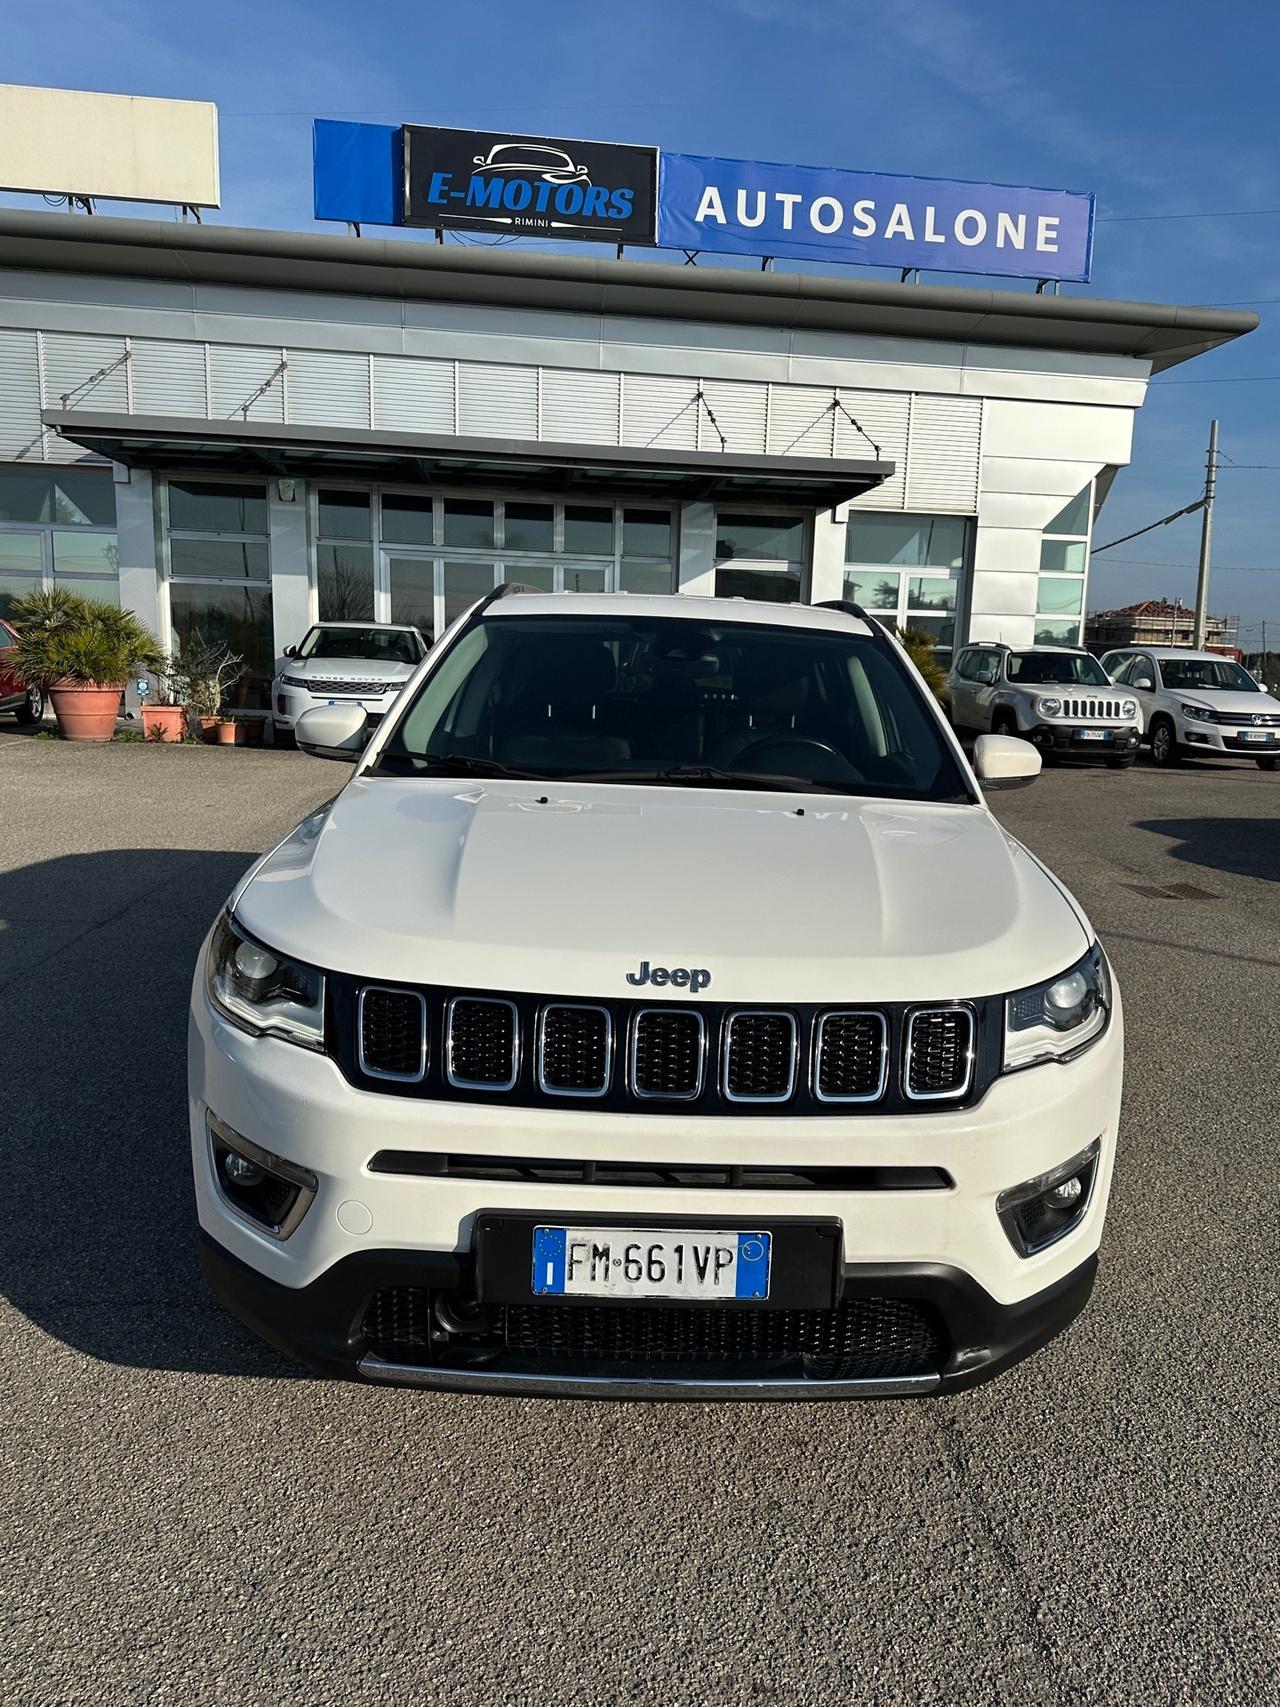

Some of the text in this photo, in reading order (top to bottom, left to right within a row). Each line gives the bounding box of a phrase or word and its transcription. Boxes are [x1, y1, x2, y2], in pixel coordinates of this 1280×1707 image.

[427, 172, 635, 219] E-MOTORS
[514, 217, 549, 227] RIMINI
[695, 185, 1060, 253] AUTOSALONE
[626, 961, 712, 993] Jeep
